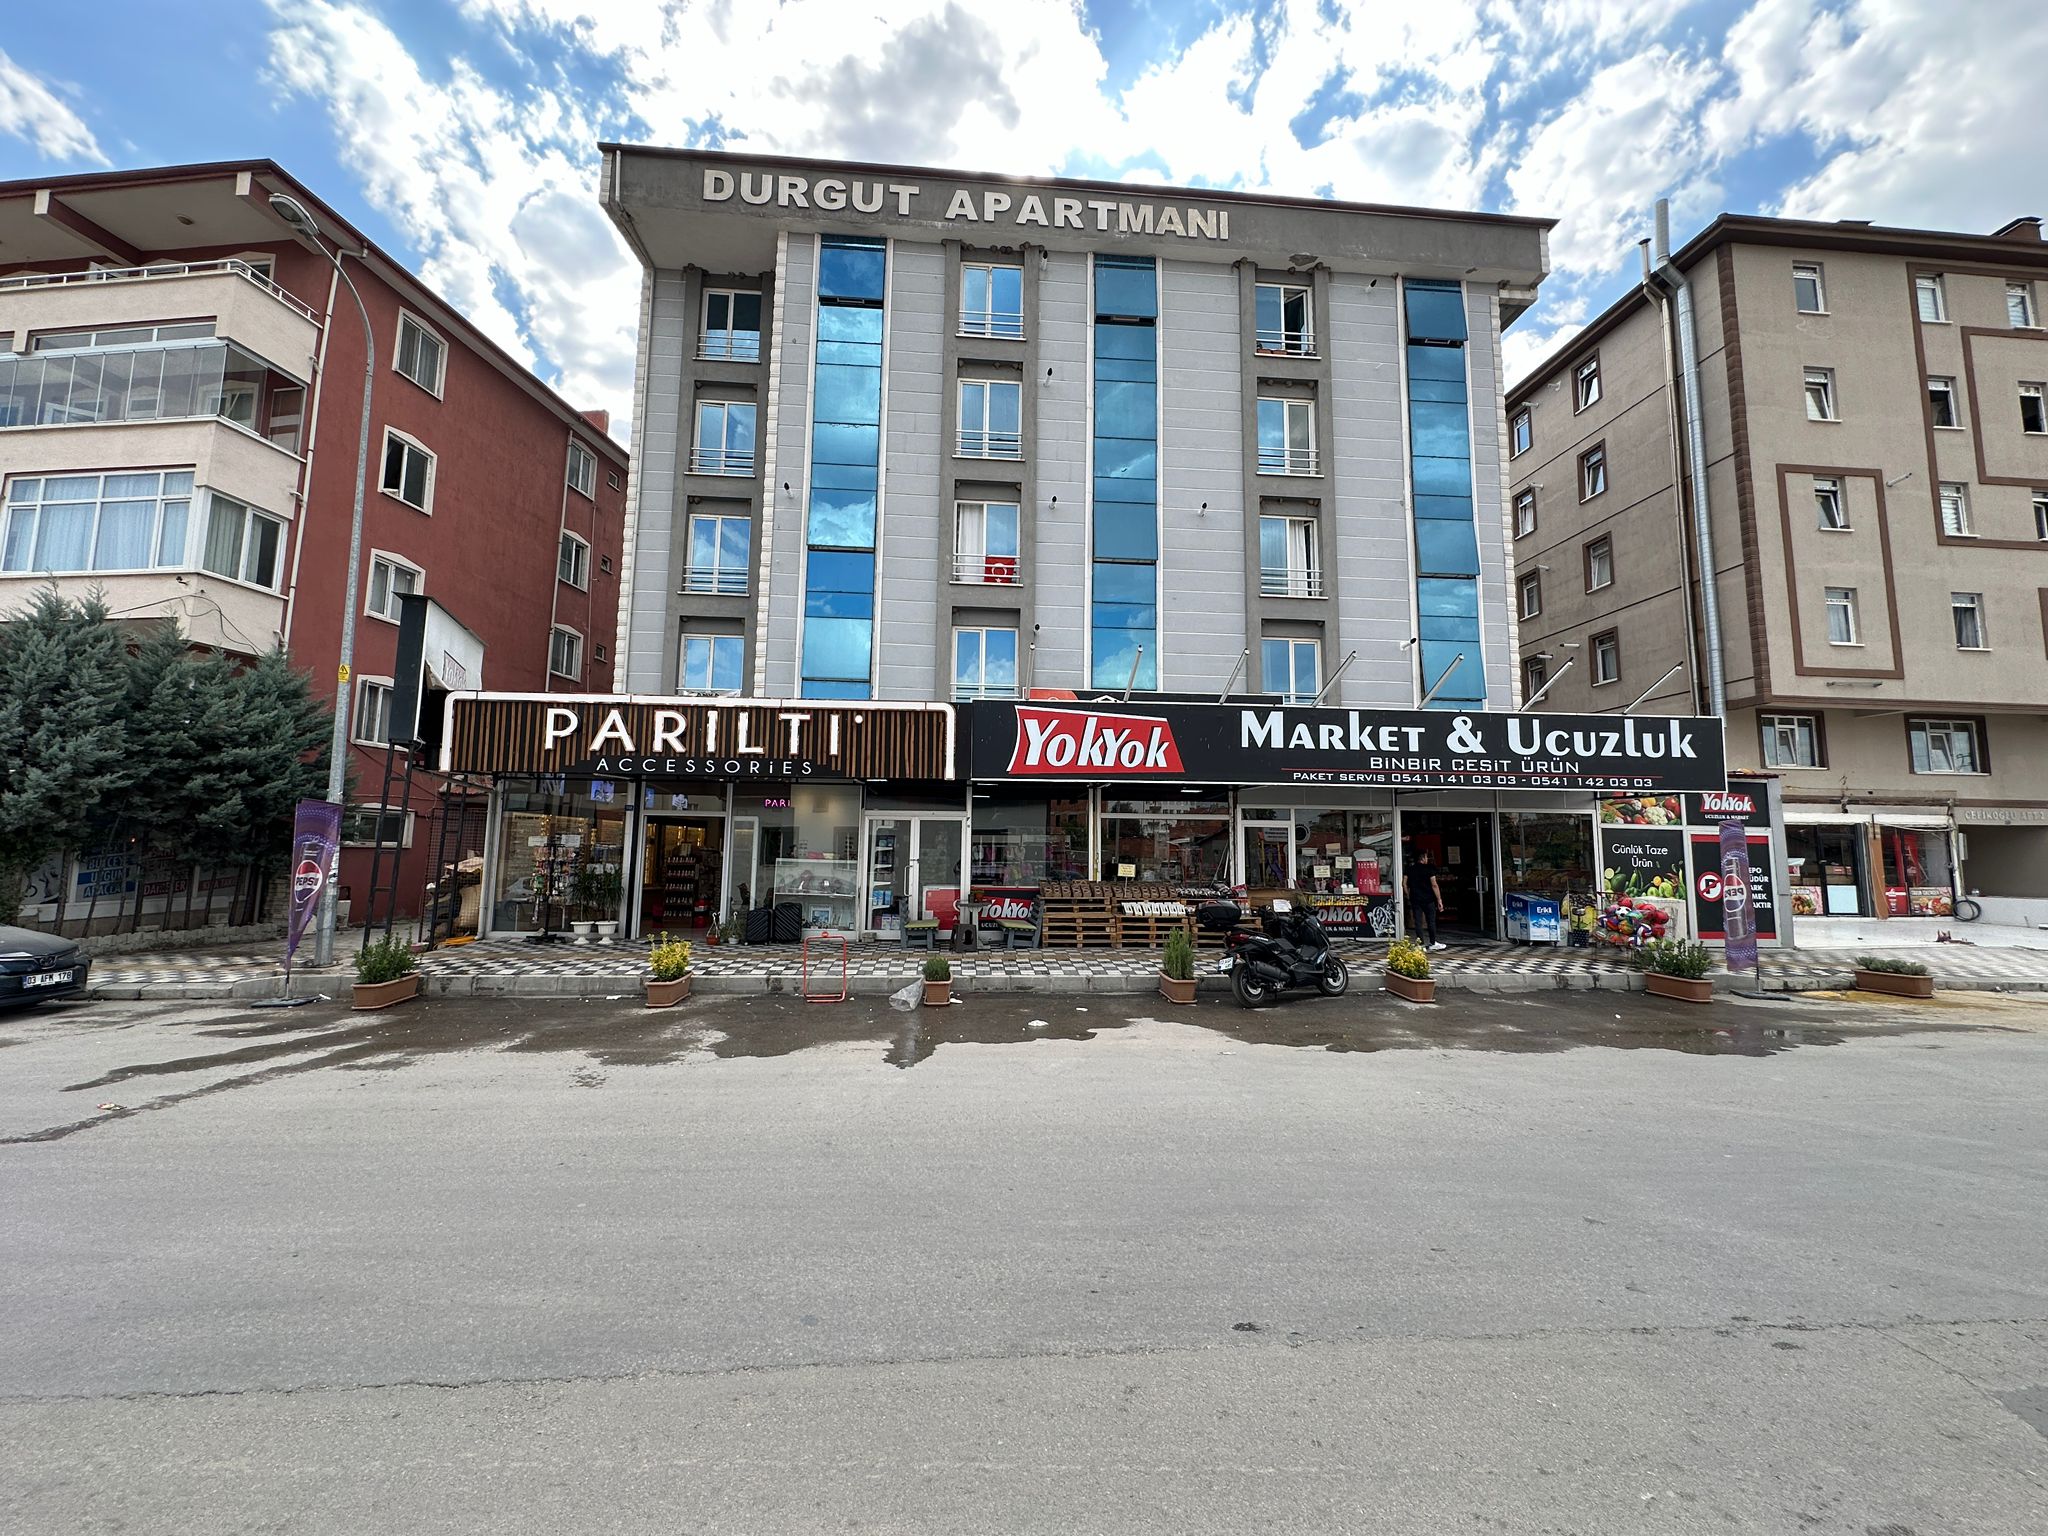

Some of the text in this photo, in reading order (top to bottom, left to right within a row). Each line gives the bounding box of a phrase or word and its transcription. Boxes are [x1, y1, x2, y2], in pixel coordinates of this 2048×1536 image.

[702, 169, 1230, 240] DURGUT APARTMANI
[544, 707, 839, 756] PARILTI
[1446, 716, 1488, 754] &
[1521, 757, 1580, 774] ÜRÜN
[1293, 772, 1334, 781] PAKET
[1391, 774, 1430, 783] 0541
[1439, 775, 1465, 784] 141
[1472, 775, 1492, 784] 03
[1497, 776, 1517, 785] 03
[1531, 777, 1568, 786] 0541
[1577, 778, 1604, 787] 142
[1609, 778, 1629, 787] 03
[1634, 779, 1653, 788] 03
[1644, 844, 1669, 855] Taze
